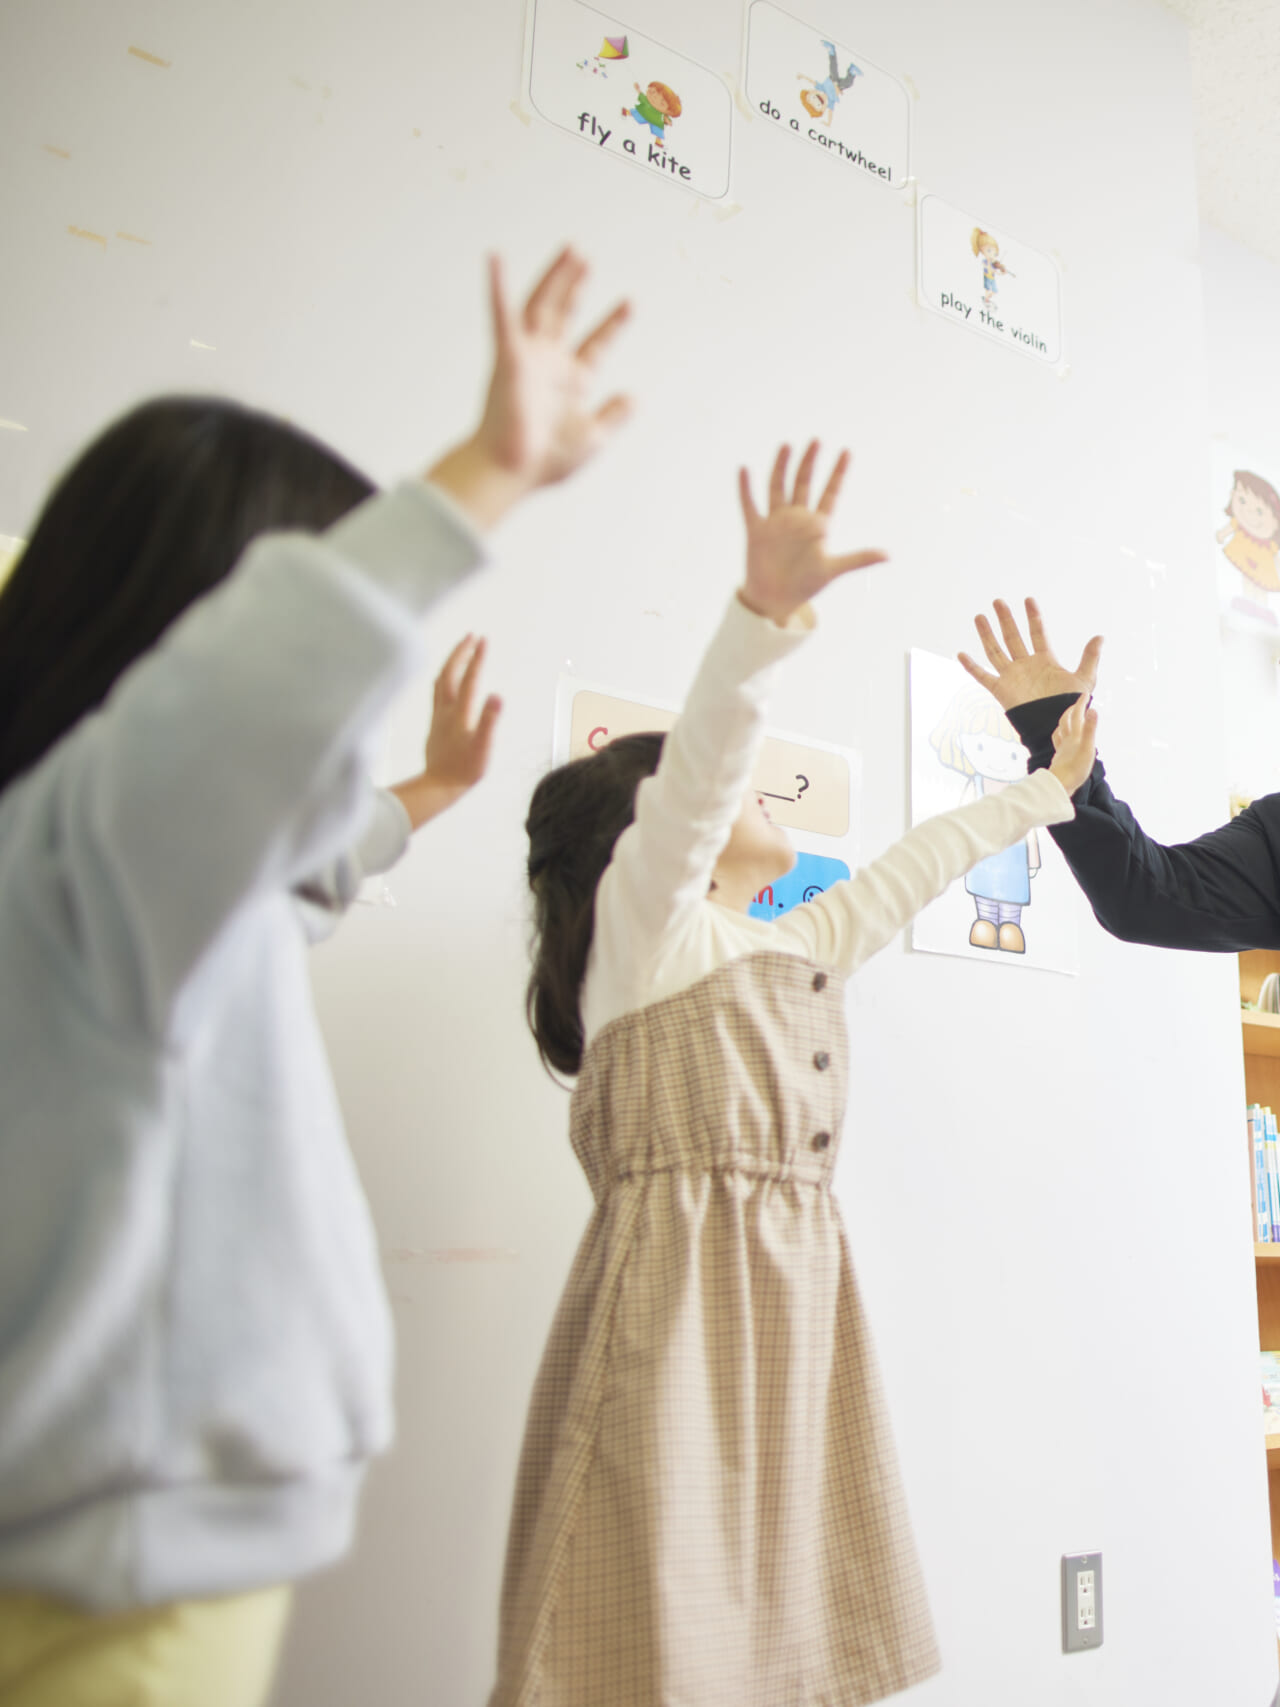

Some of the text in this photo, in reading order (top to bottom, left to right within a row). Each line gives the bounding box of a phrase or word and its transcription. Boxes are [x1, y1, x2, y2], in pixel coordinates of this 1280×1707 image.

[577, 112, 692, 181] fly a kite
[758, 100, 892, 182] do a cartwheel
[940, 292, 1048, 354] play the violin
